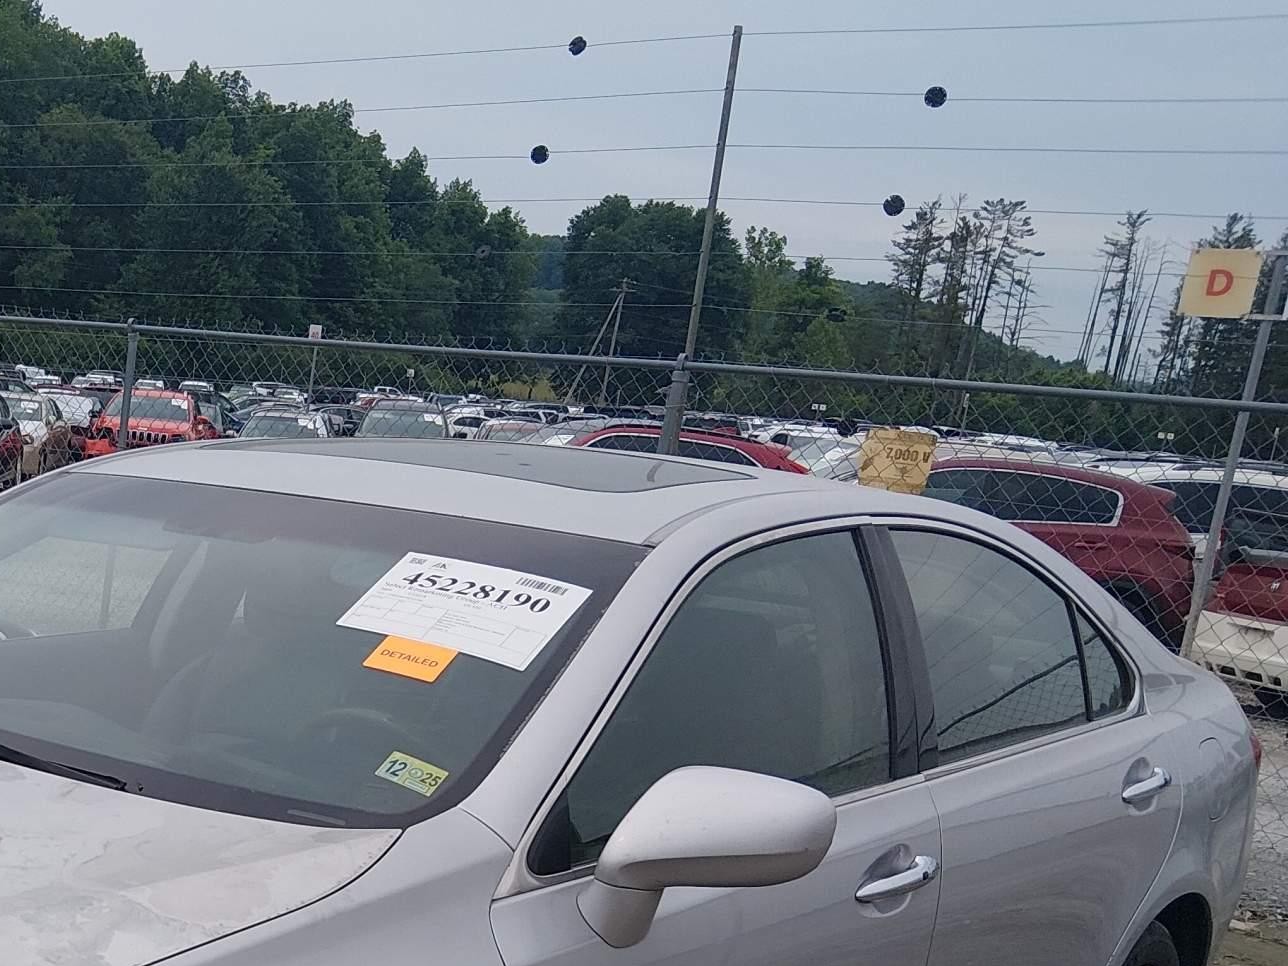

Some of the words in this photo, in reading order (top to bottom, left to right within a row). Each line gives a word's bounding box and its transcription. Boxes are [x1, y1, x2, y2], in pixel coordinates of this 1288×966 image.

[1205, 269, 1235, 297] D
[402, 571, 552, 613] 45228190
[379, 648, 439, 670] DETAILED
[385, 759, 408, 777] 12
[419, 772, 442, 788] 25
